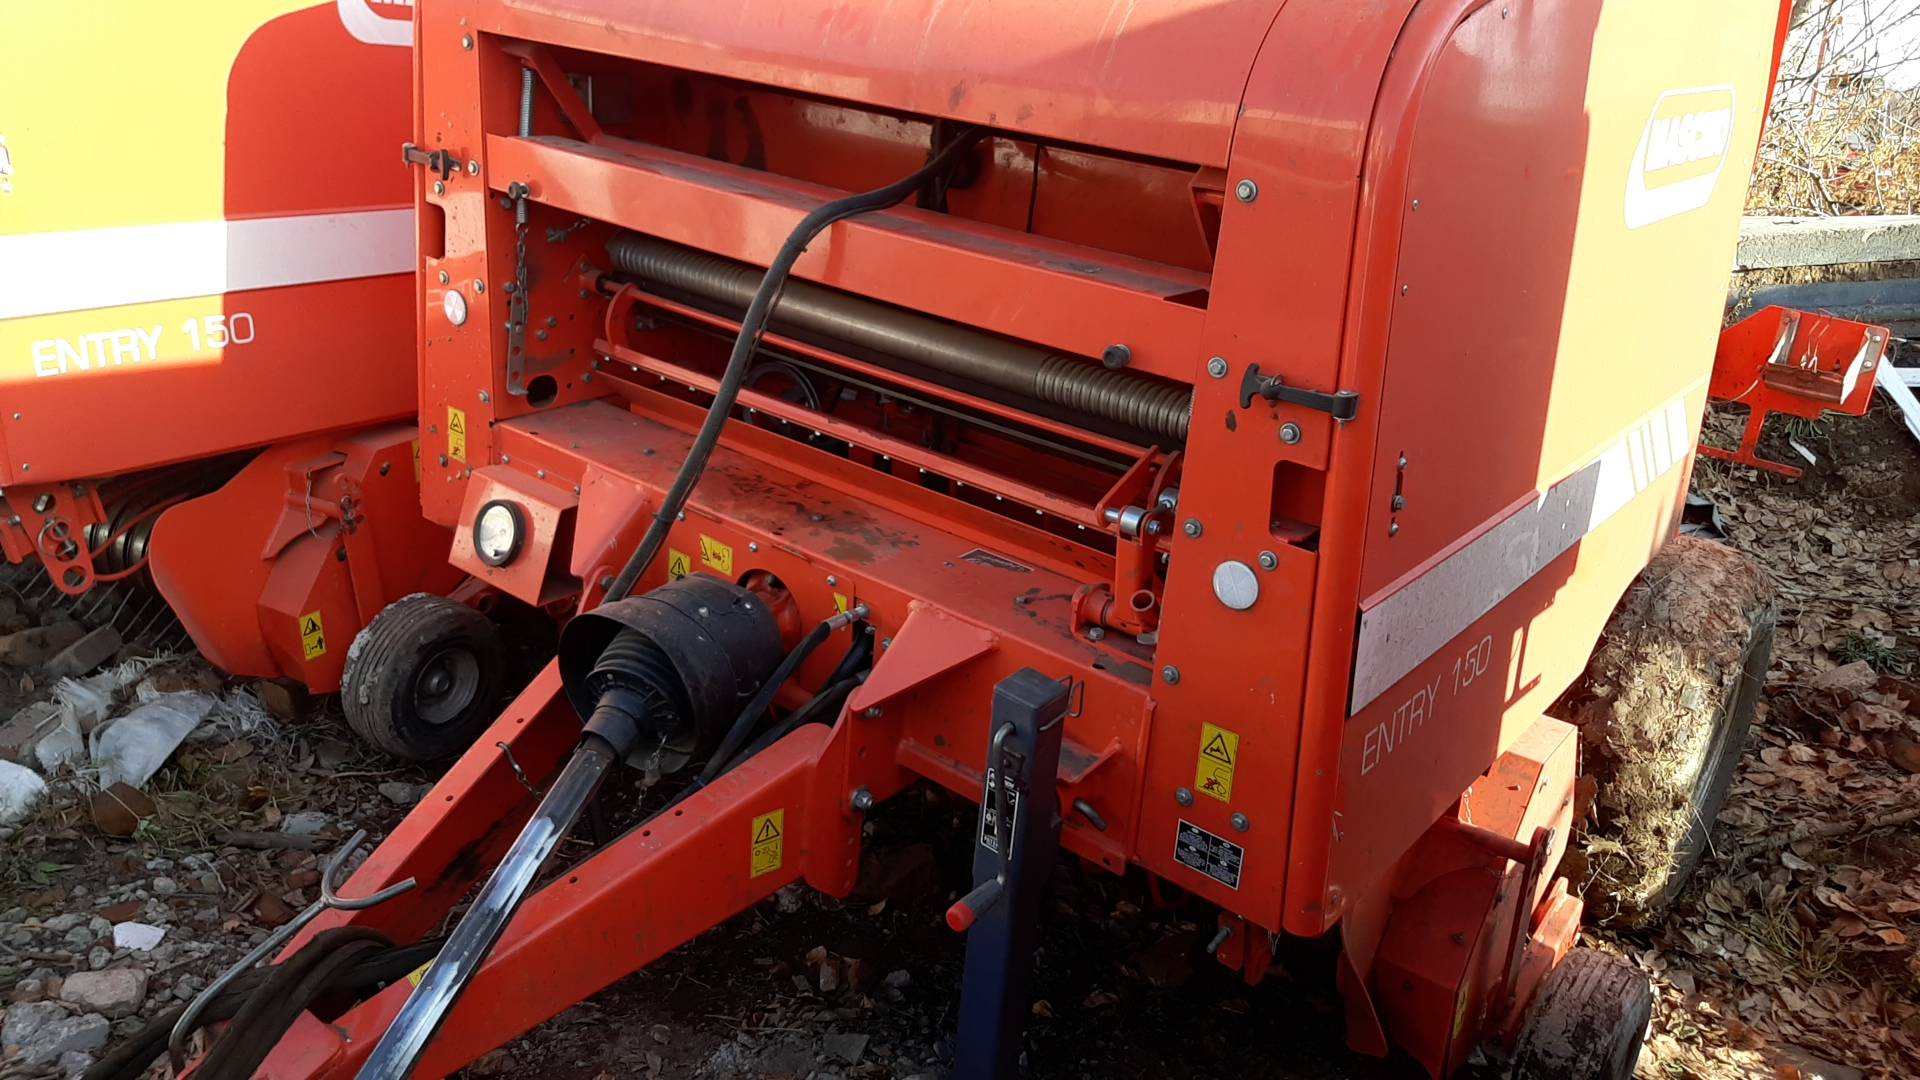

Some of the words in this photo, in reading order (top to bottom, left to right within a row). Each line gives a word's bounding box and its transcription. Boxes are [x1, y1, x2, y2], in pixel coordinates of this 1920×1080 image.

[31, 325, 164, 378] ENTRY
[181, 312, 255, 352] 150
[1361, 673, 1442, 776] ENTRY
[1452, 634, 1493, 697] 150
